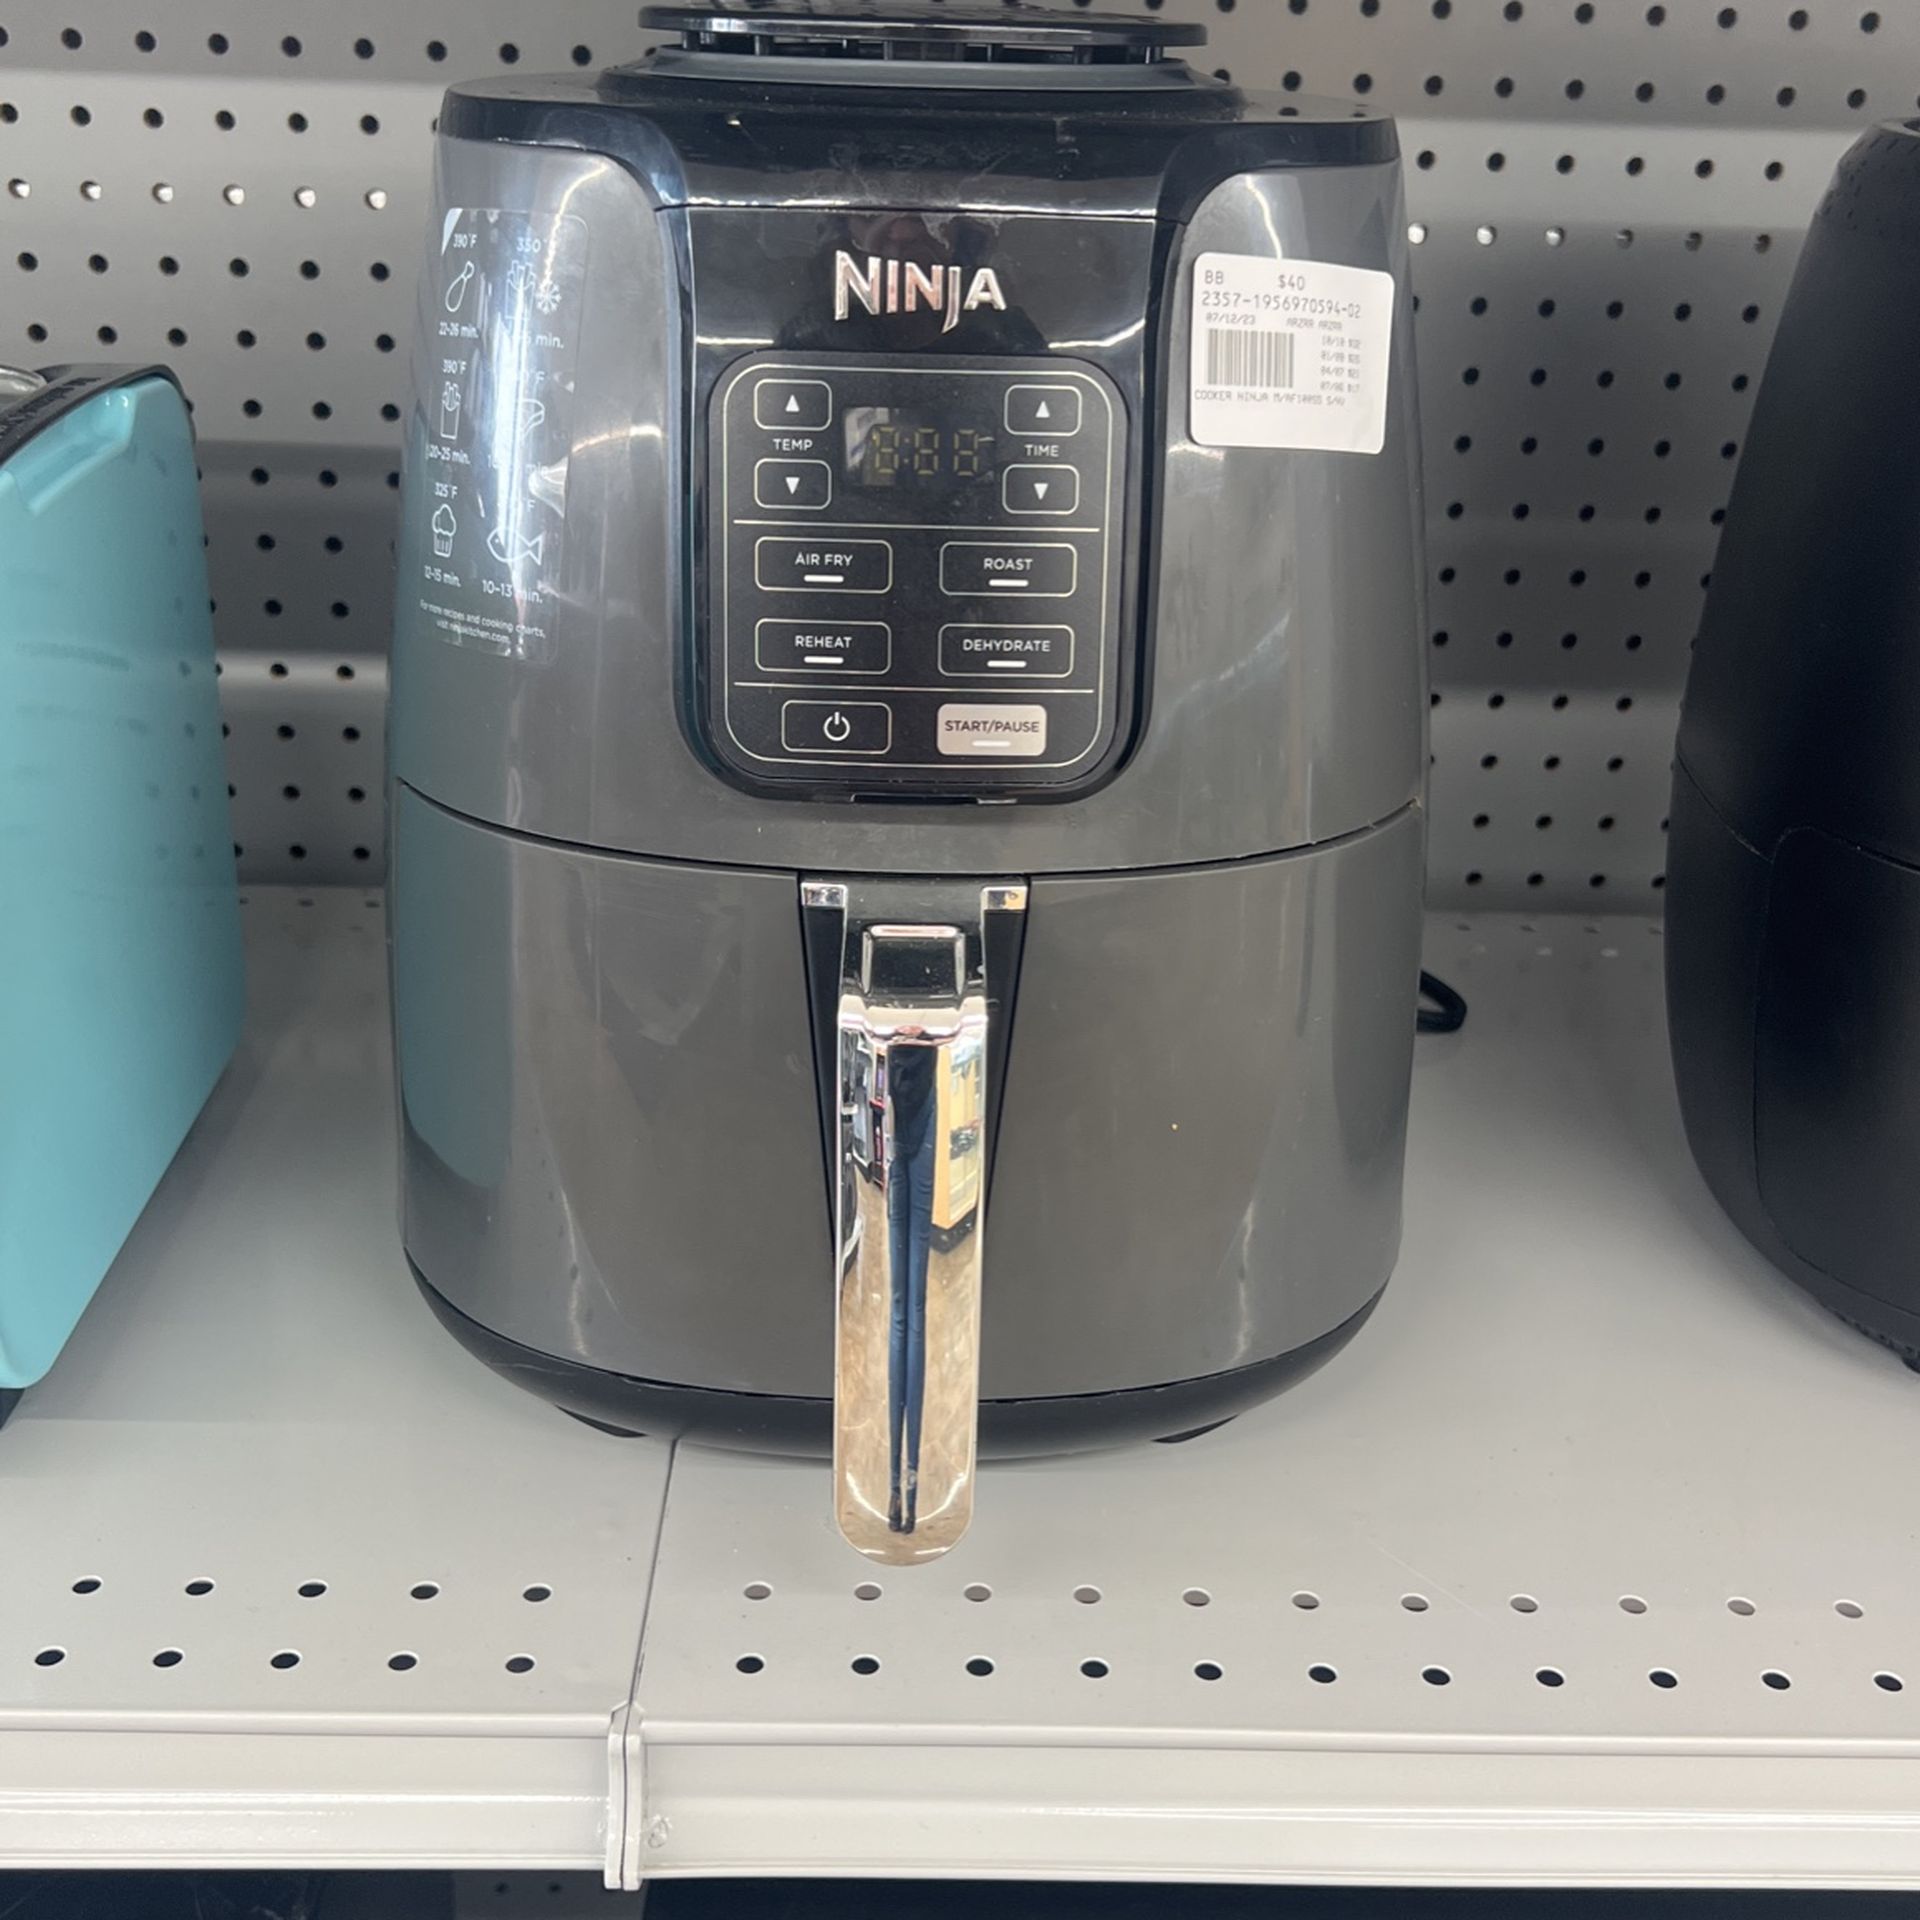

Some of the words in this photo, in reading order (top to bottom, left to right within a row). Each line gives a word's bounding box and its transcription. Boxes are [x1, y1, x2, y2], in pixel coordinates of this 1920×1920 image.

[1277, 274, 1305, 291] $40
[834, 250, 1007, 333] NINJA
[1202, 290, 1361, 318] 2357-1956970594-02
[1194, 389, 1232, 402] COOKER
[1237, 391, 1269, 402] NINJA
[773, 438, 814, 451] TEMP
[1024, 444, 1060, 457] TIME
[795, 552, 820, 567] AIR
[824, 553, 854, 568] FRY
[984, 558, 1033, 571] ROAST
[482, 579, 514, 598] 10-13
[467, 613, 480, 625] and
[481, 617, 514, 634] cooking
[794, 635, 852, 649] REHEAT
[962, 638, 1051, 652] DEHYDRATE
[944, 720, 1040, 734] START/PAUSE
